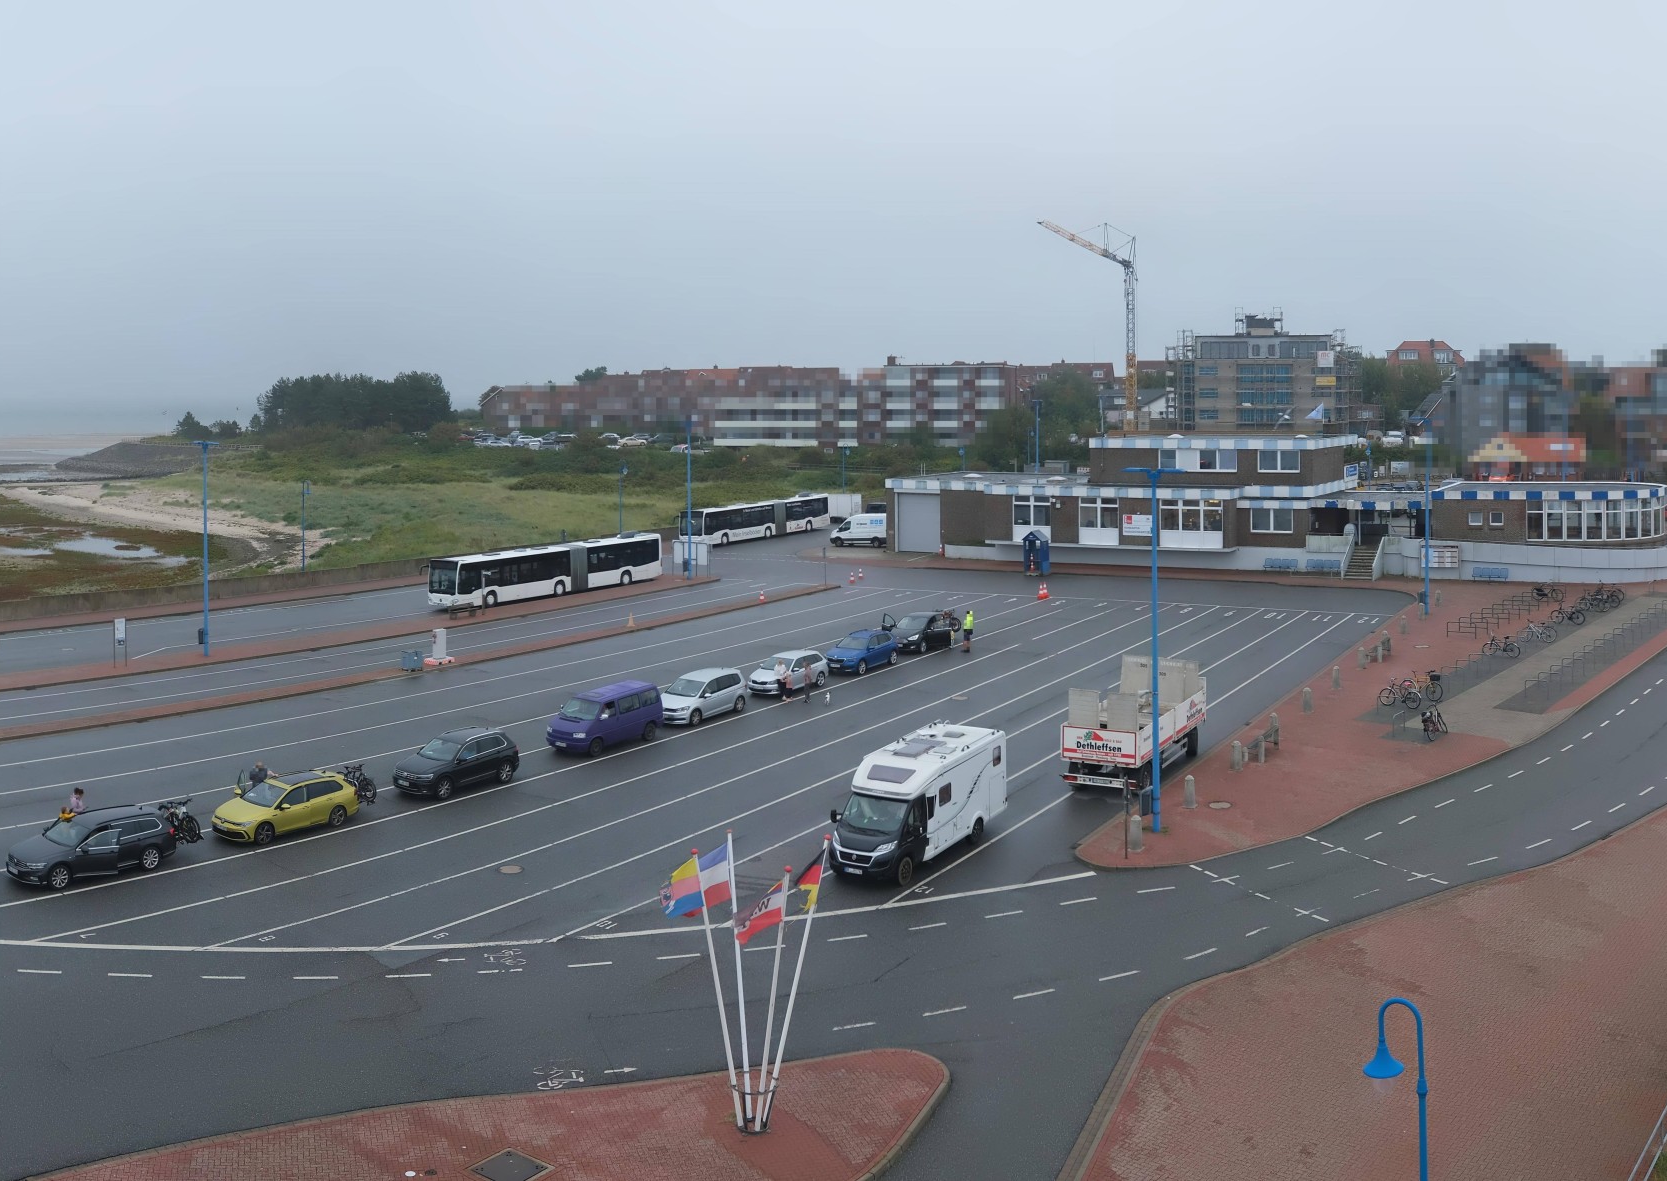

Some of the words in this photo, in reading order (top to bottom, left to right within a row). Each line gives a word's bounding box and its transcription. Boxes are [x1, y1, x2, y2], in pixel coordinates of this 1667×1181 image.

[1076, 741, 1122, 752] Dethleffsen
[914, 885, 934, 894] 12
[596, 920, 617, 929] 10
